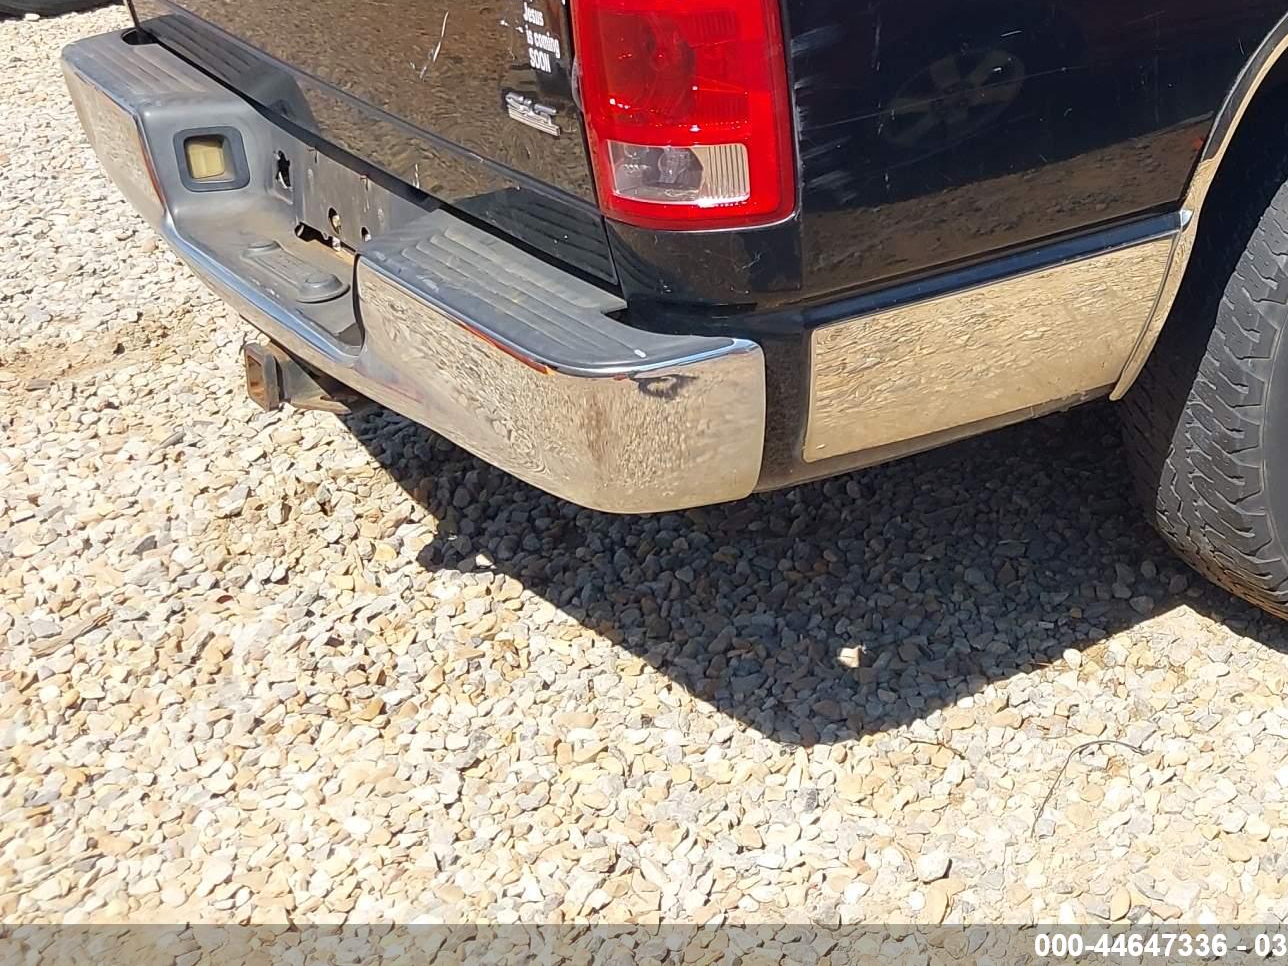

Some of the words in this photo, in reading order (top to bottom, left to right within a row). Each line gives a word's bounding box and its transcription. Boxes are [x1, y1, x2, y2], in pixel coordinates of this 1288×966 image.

[523, 1, 545, 27] Jesus
[525, 24, 534, 46] is
[533, 31, 561, 59] coming
[528, 47, 552, 74] SOON
